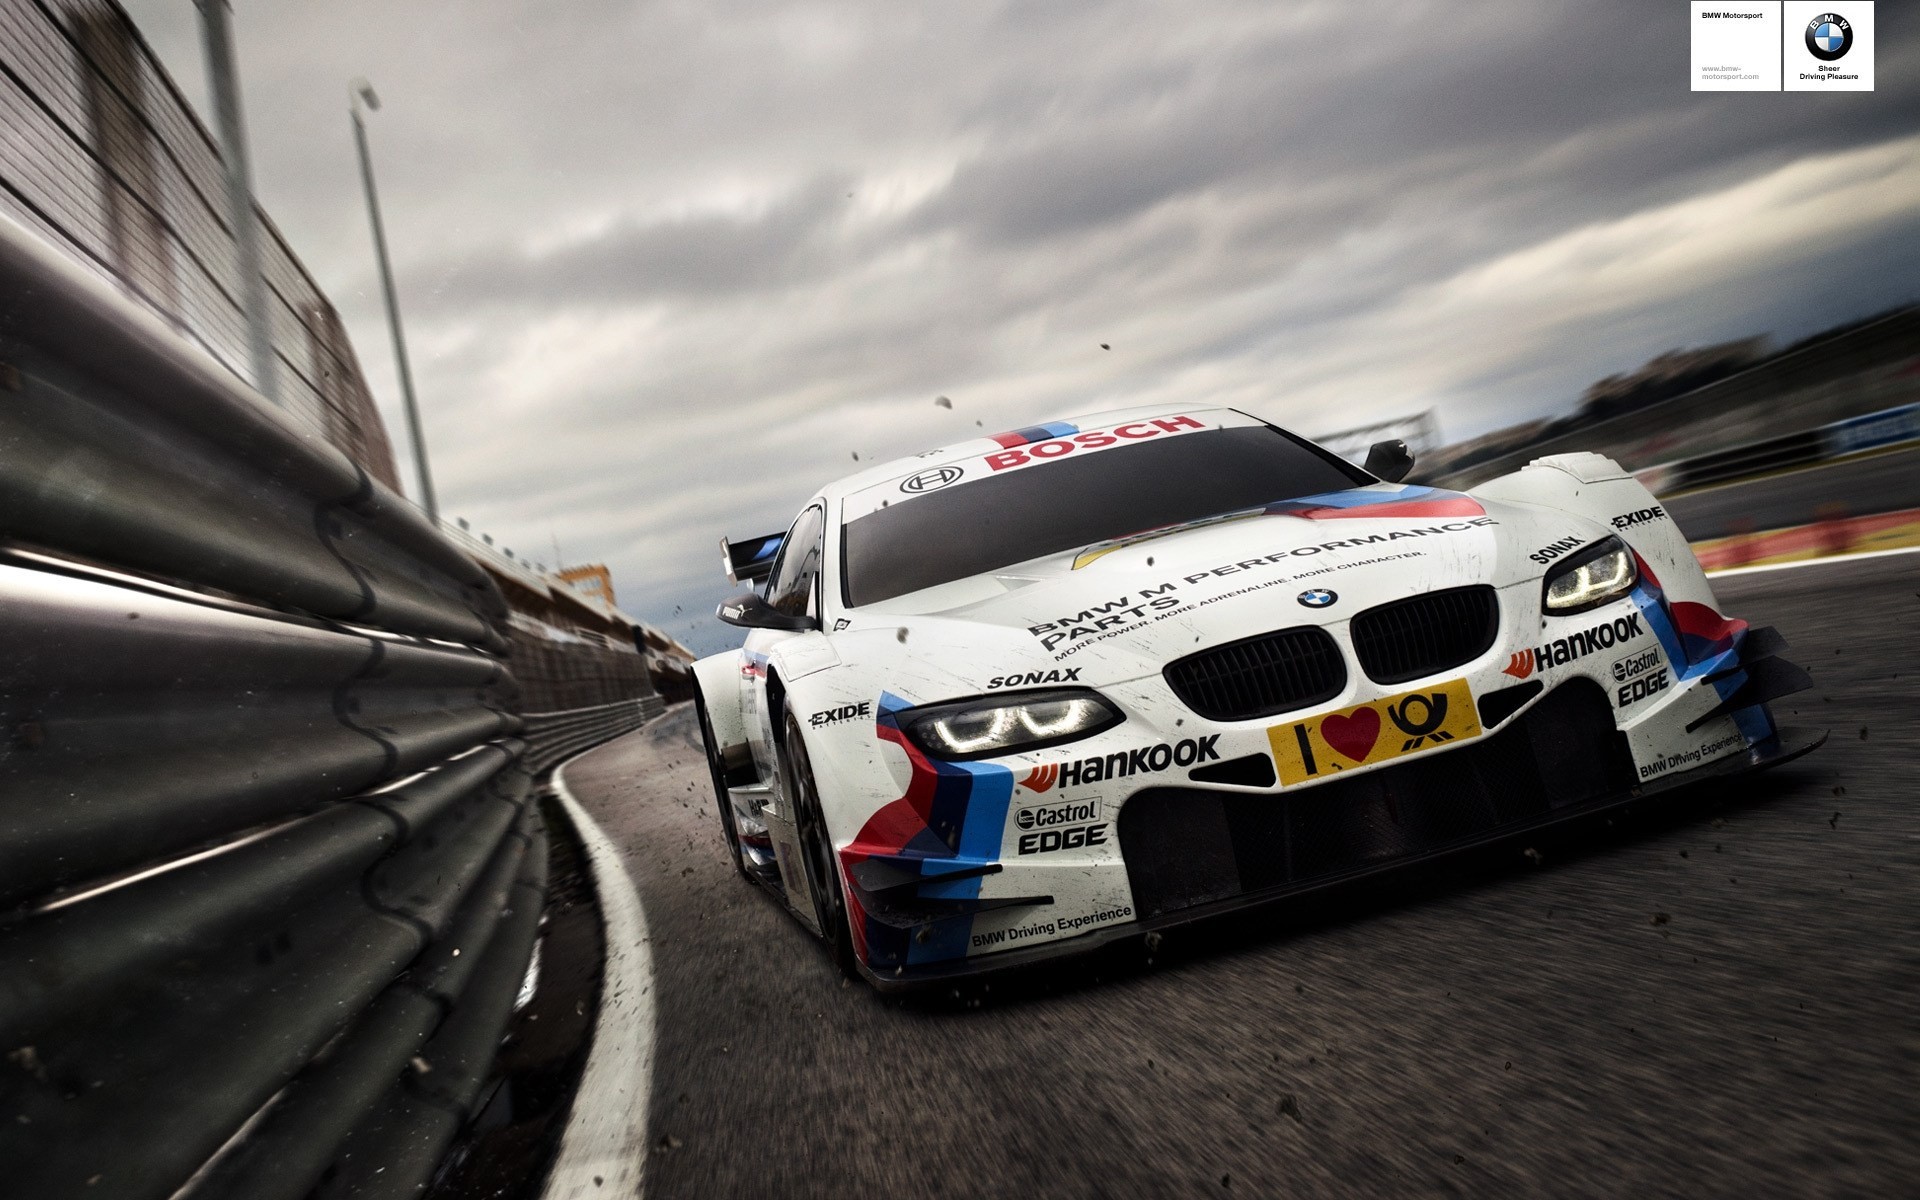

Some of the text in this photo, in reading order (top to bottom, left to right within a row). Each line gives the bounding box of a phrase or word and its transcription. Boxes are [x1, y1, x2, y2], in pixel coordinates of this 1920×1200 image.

[983, 415, 1206, 472] BOSCH
[1611, 506, 1665, 529] EXIDE
[1529, 535, 1586, 565] SONAX
[1027, 517, 1500, 637] BMW M PERFORMANCE
[1040, 596, 1180, 652] PARTS
[1054, 550, 1427, 662] MORE POWER. MORE ADRENALINE. MORE CHARACTER.
[987, 667, 1083, 690] SONAX
[1625, 650, 1661, 677] Castrol
[1618, 667, 1670, 708] EDGE
[808, 702, 870, 727] EXIDE
[1640, 733, 1742, 778] BMW Driving Experience
[1036, 800, 1097, 827] Castrol
[1018, 823, 1109, 856] EDGE
[972, 905, 1132, 948] BMW Driving Experience
